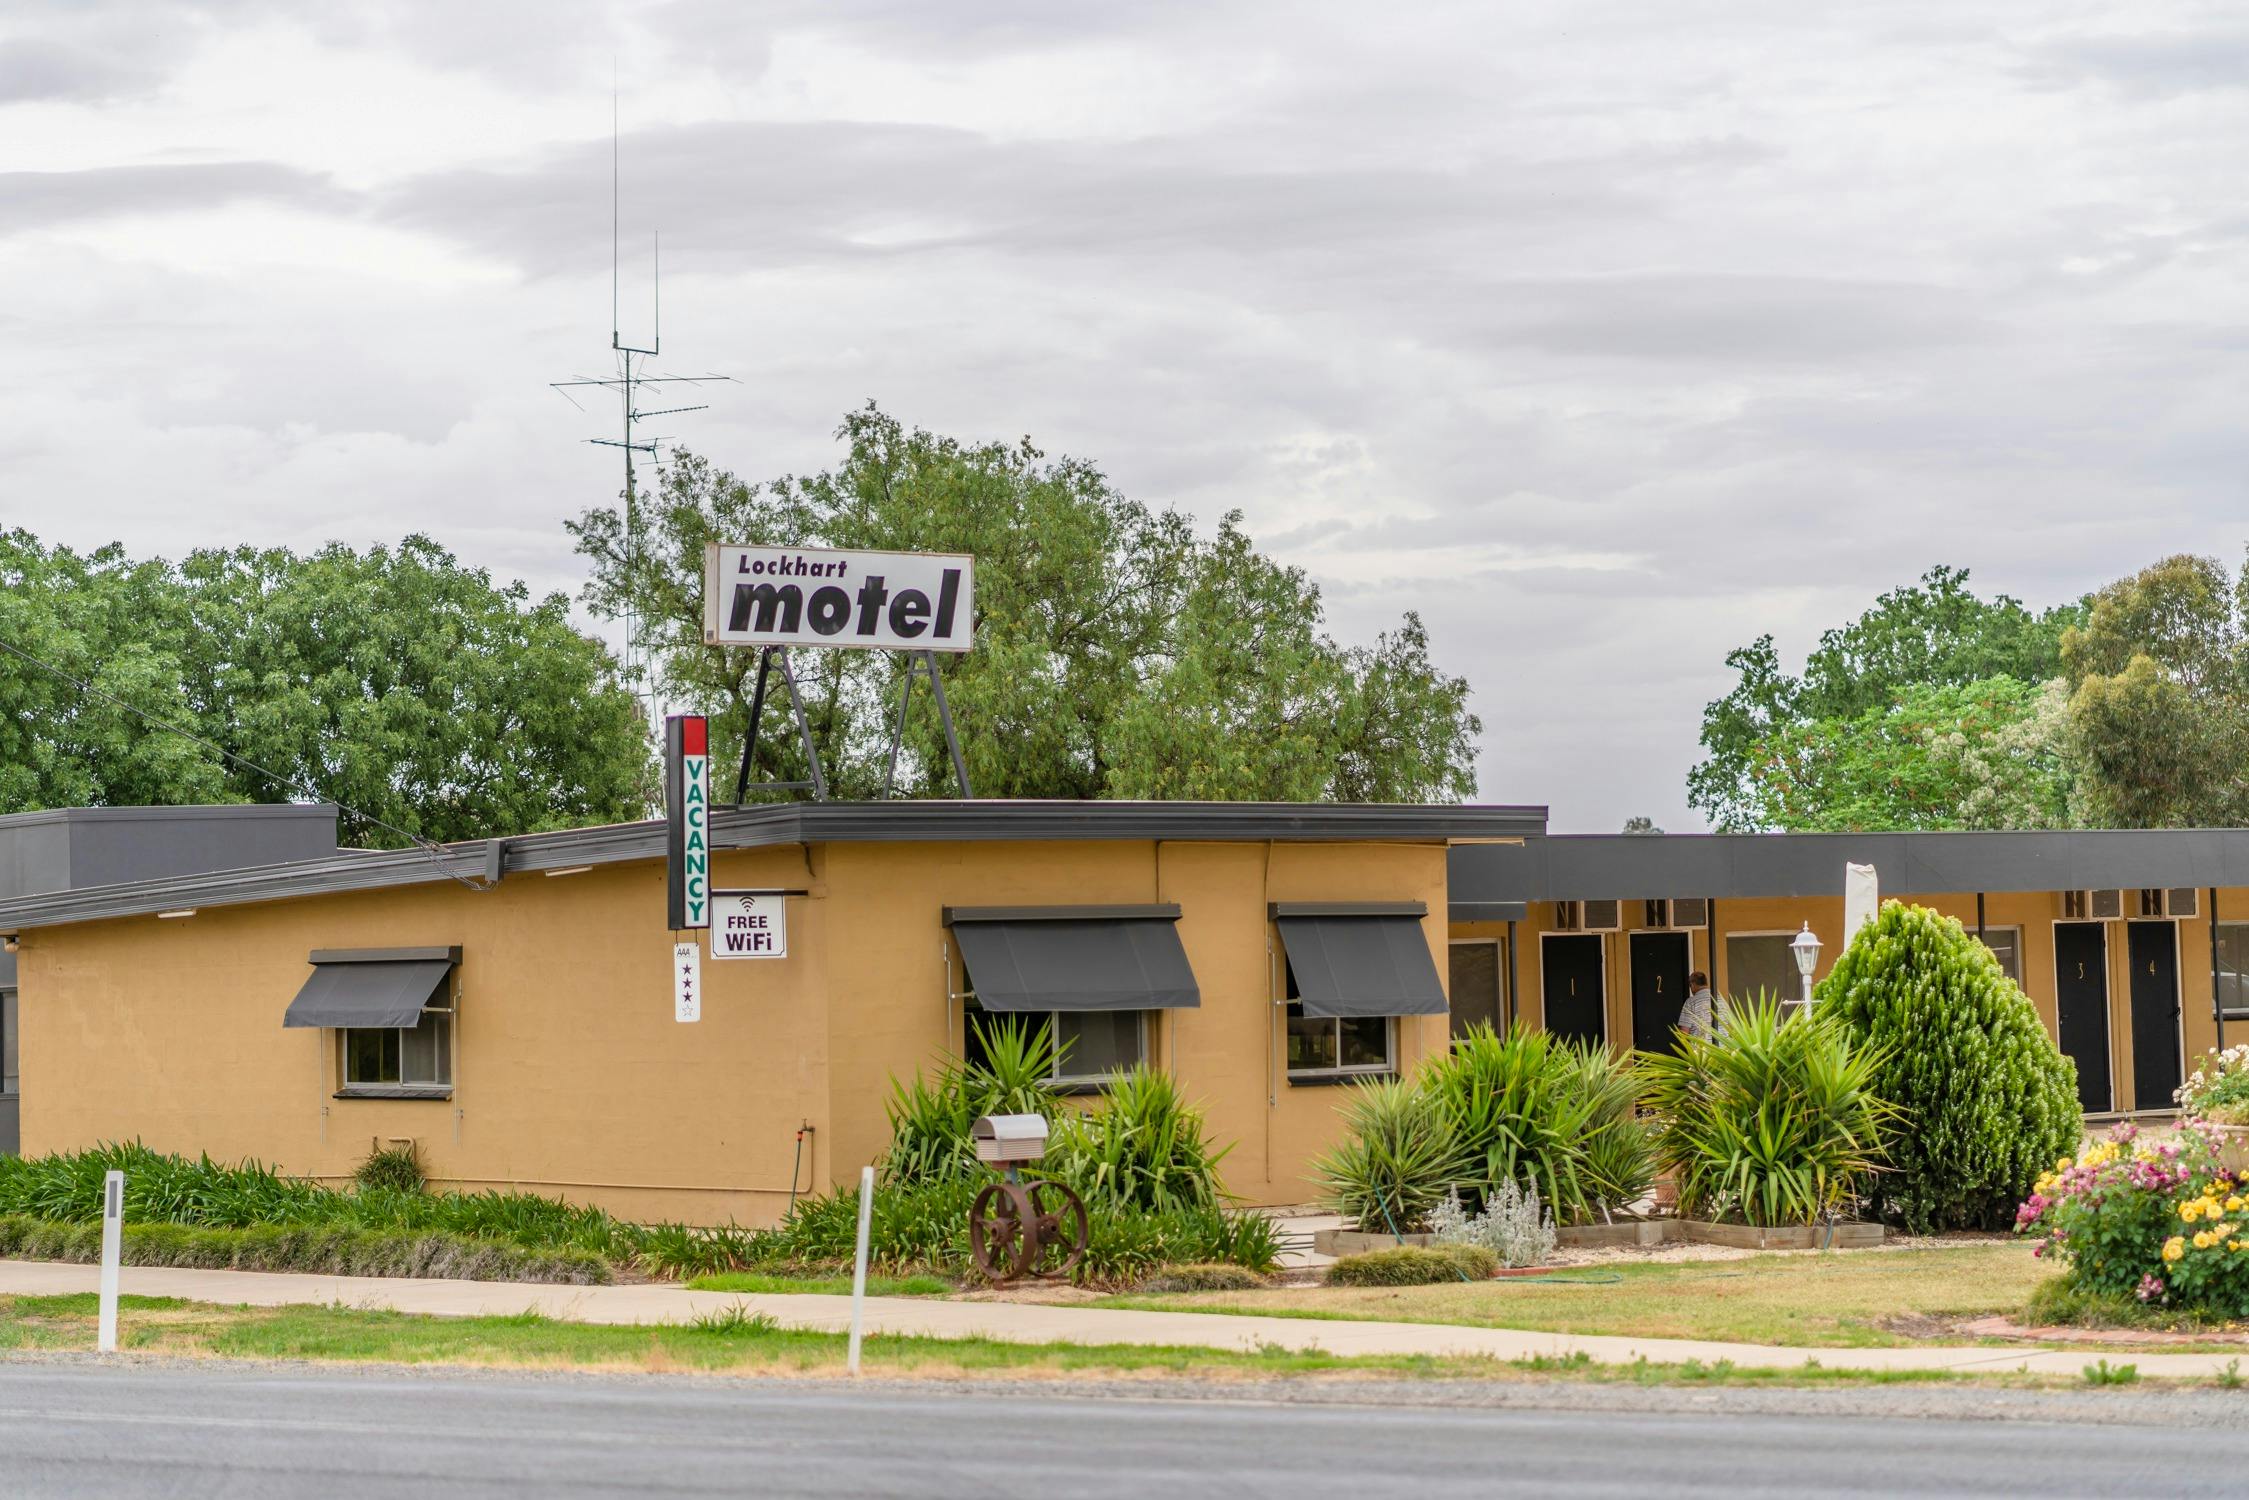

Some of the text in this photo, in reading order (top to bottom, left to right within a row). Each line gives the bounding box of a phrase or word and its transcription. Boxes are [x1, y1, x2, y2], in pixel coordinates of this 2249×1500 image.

[738, 554, 848, 578] Lockhart
[728, 568, 961, 639] motel
[686, 759, 705, 922] VACANCY
[727, 915, 768, 929] FREE
[725, 932, 772, 951] WiFi
[2078, 962, 2084, 979] 3
[2149, 960, 2155, 977] 4
[1571, 977, 1575, 996] 1
[1656, 975, 1662, 993] 2
